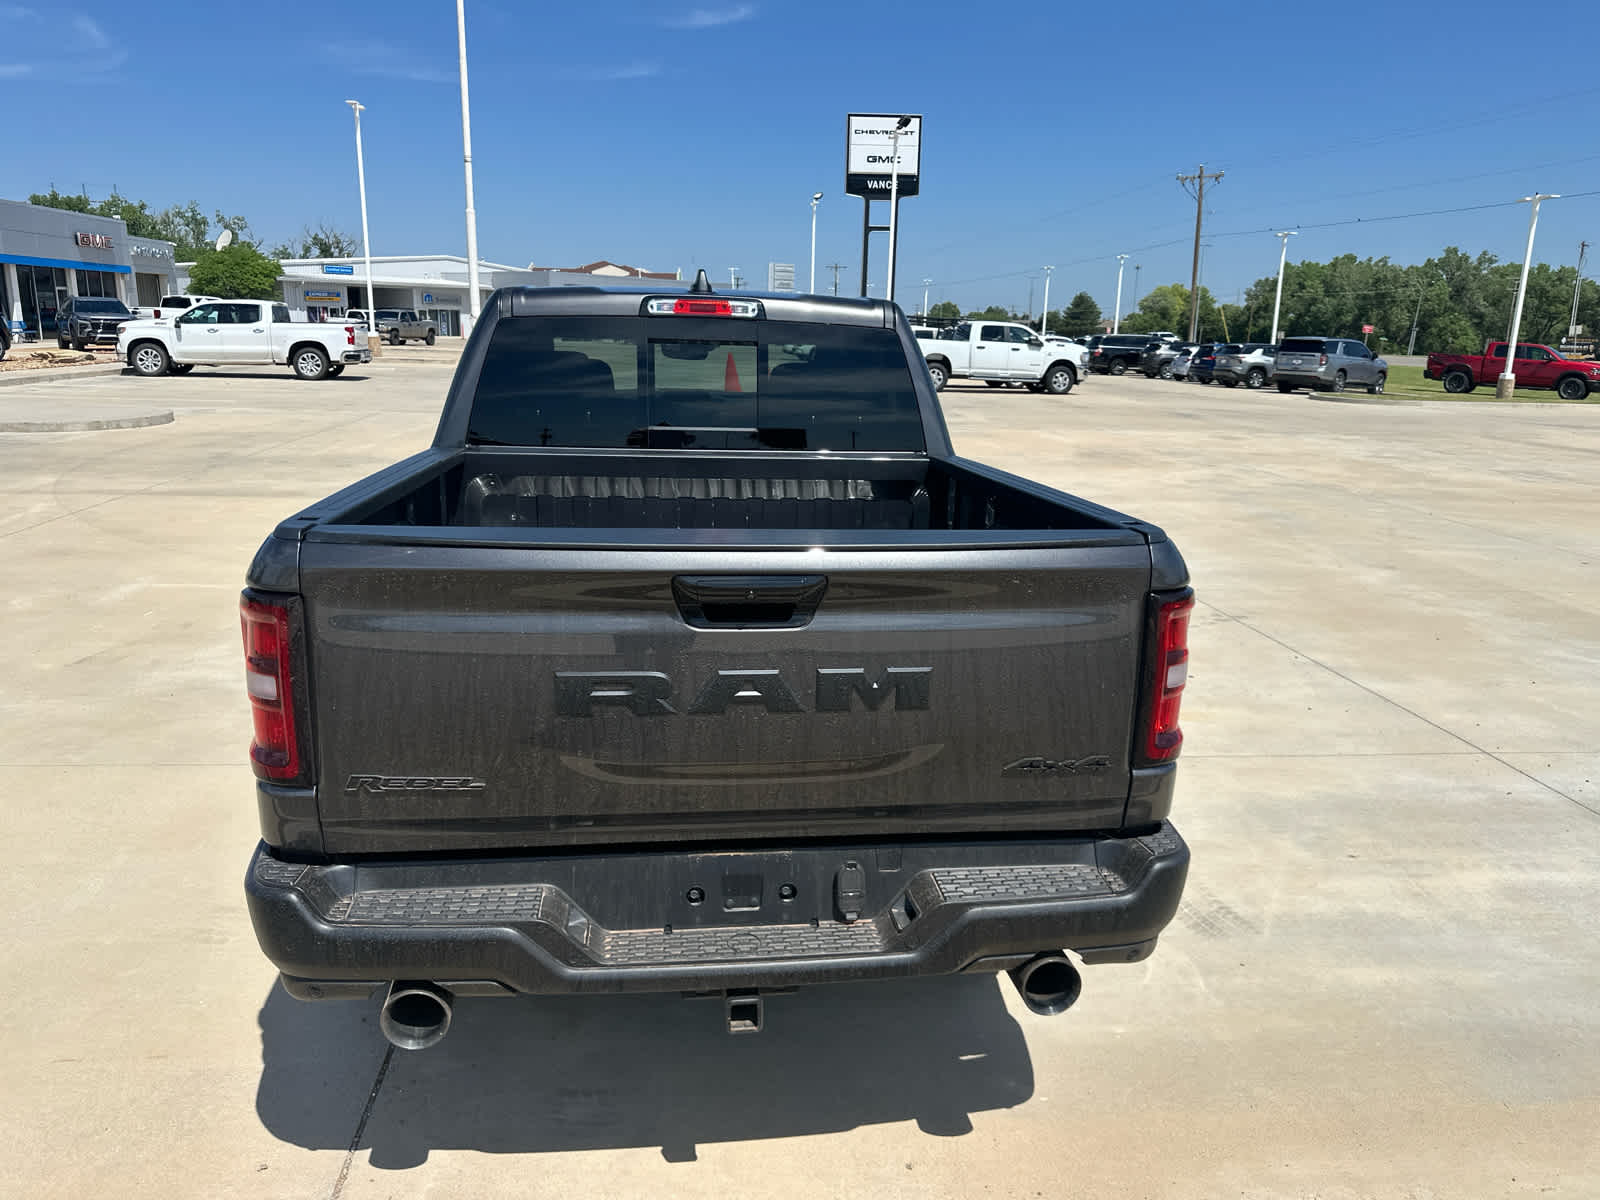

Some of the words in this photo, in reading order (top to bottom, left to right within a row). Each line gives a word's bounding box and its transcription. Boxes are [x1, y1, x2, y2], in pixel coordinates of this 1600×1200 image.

[866, 155, 901, 164] GMC
[77, 231, 113, 249] GMC
[554, 666, 934, 717] RAM
